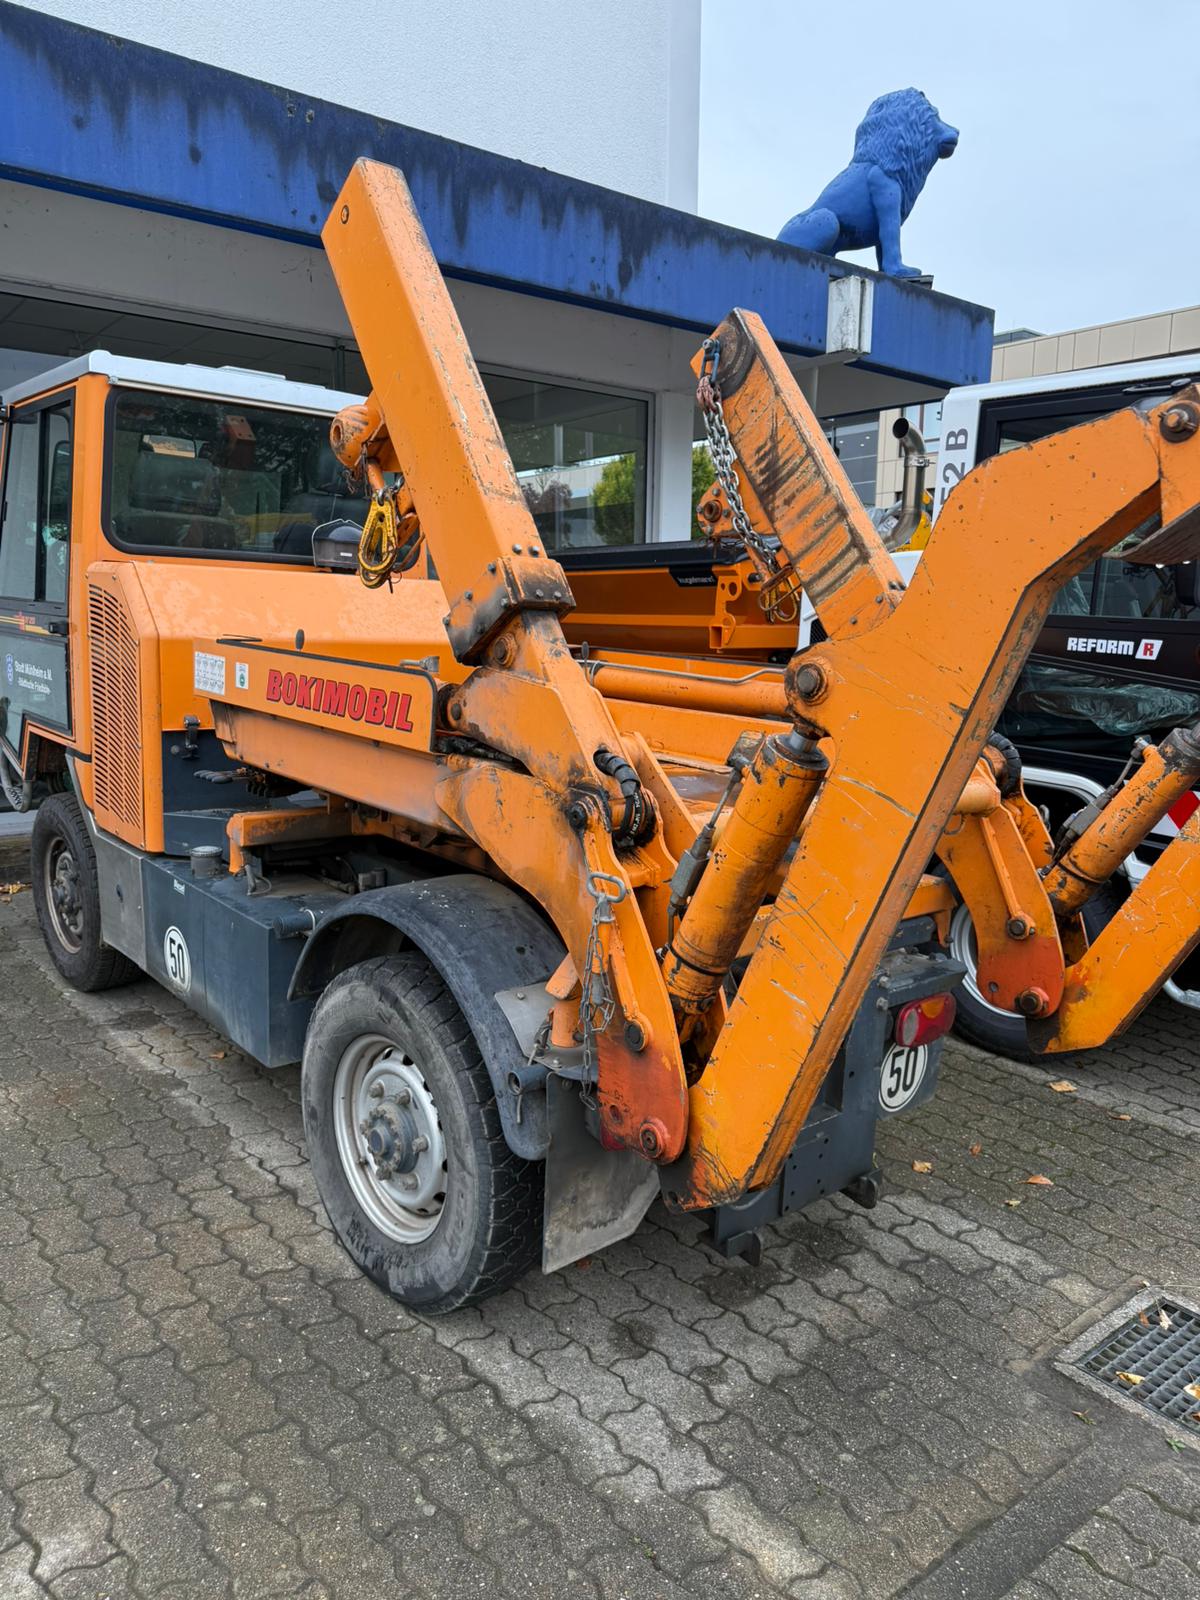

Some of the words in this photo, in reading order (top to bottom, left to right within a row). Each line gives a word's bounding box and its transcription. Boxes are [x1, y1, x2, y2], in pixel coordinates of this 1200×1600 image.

[1066, 636, 1135, 656] REFORM
[266, 668, 414, 733] BOKIMOBIL
[168, 936, 186, 985] 50
[887, 1046, 919, 1099] 50
